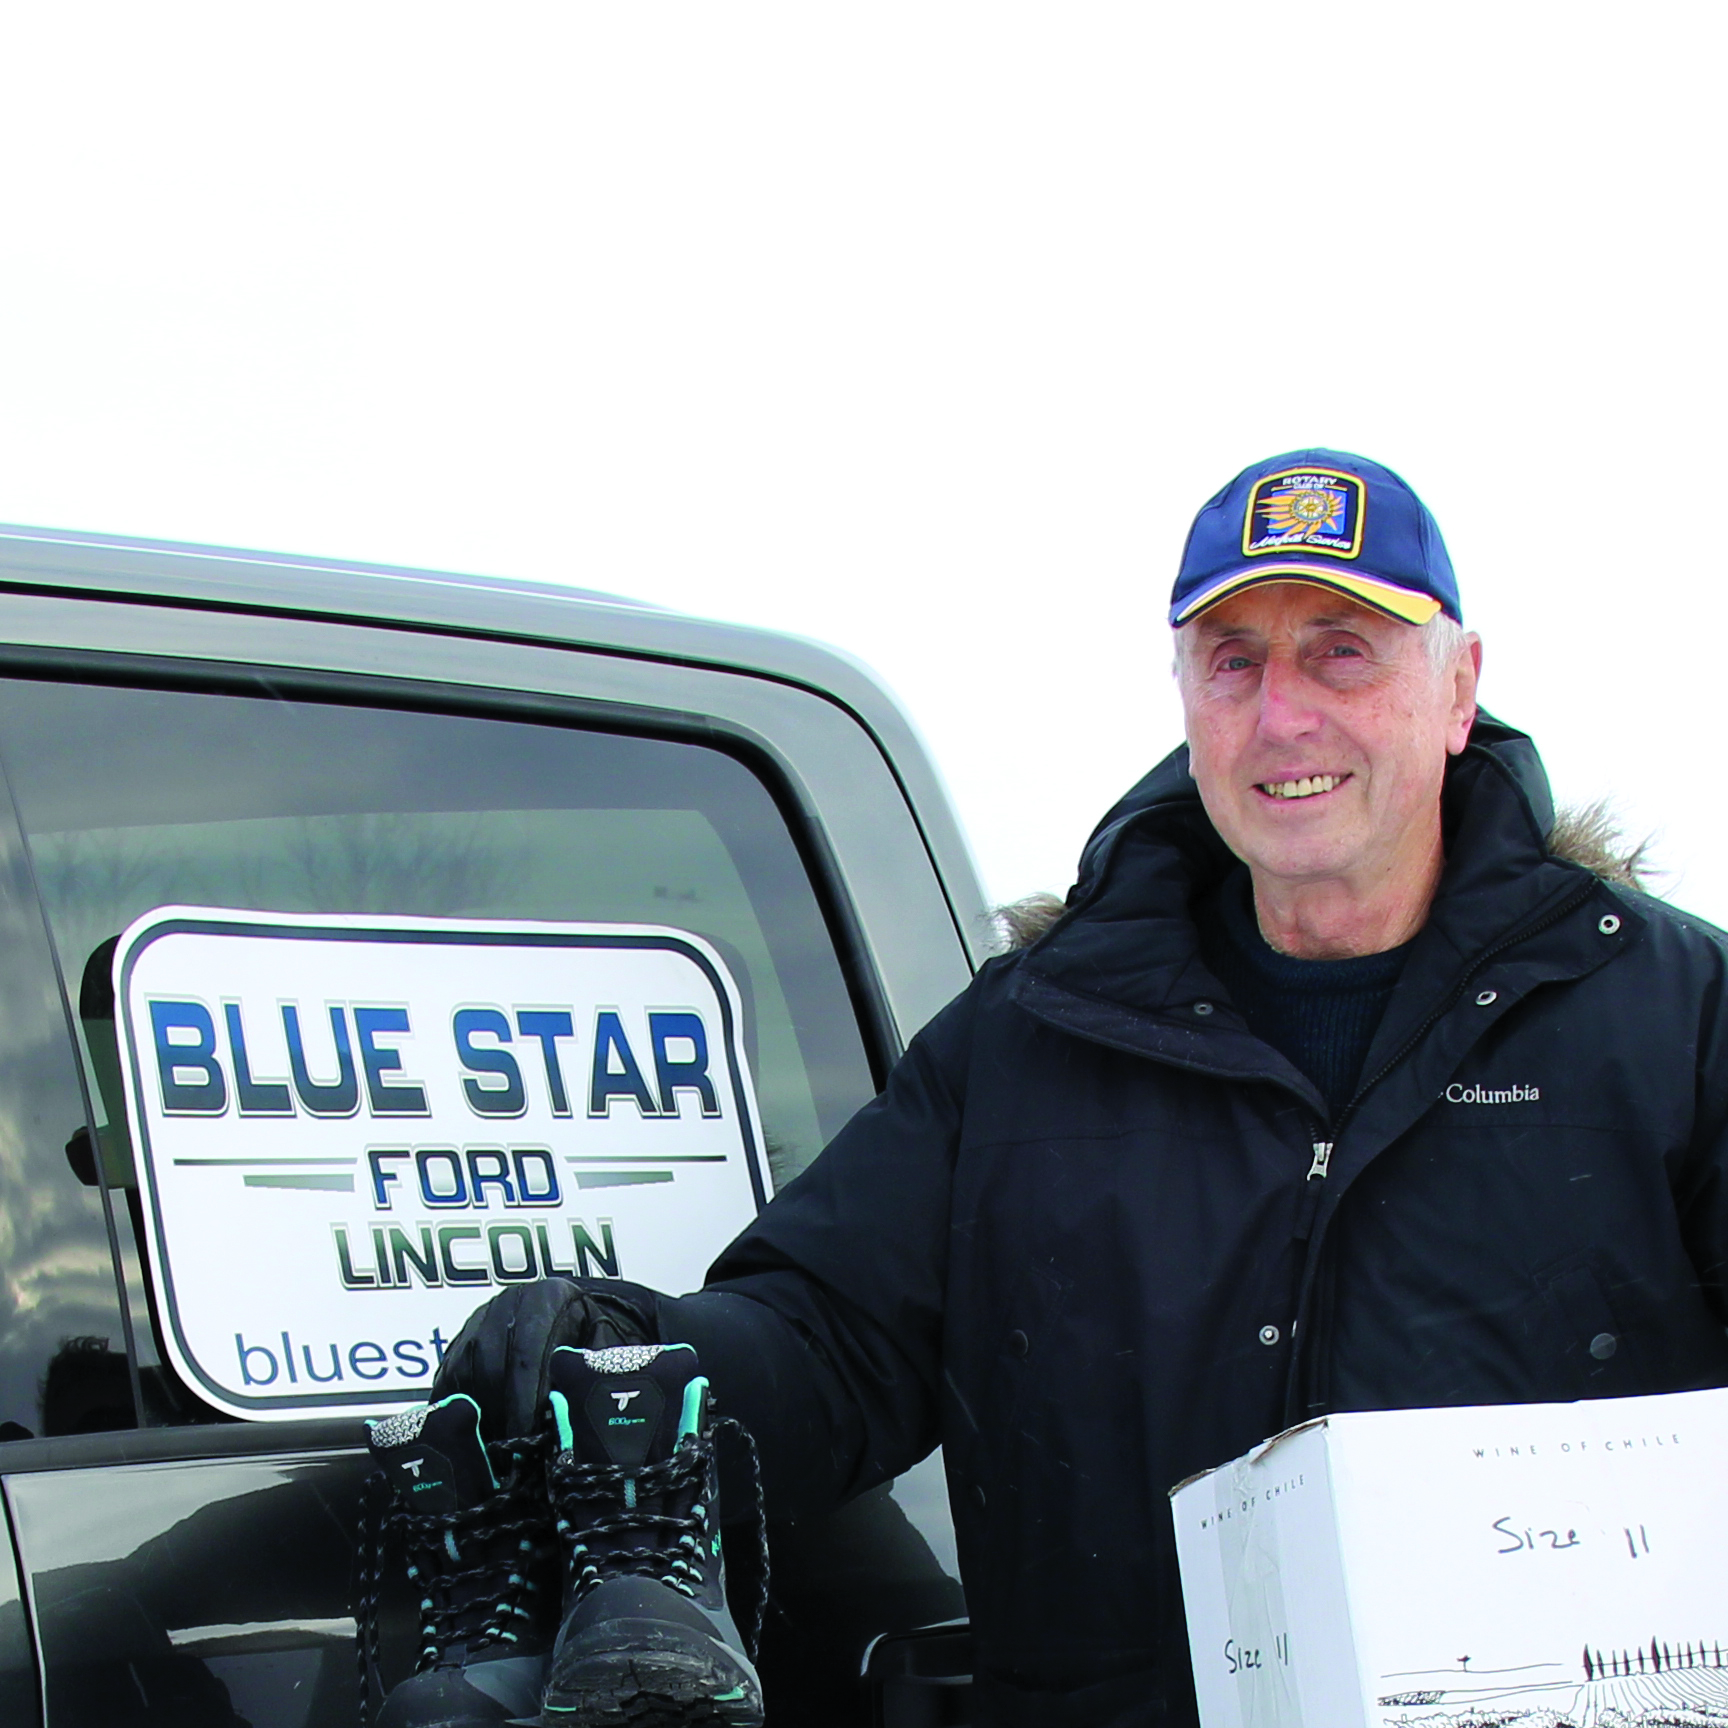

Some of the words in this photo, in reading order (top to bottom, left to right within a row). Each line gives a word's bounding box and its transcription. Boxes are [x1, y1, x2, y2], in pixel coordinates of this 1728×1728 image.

[1282, 475, 1338, 486] ROTARY
[146, 996, 430, 1117] BLUE
[452, 1004, 722, 1119] STAR
[1446, 1083, 1540, 1104] Columbia
[366, 1144, 563, 1209] FORD
[332, 1218, 622, 1290] LINCOLN
[235, 1326, 448, 1385] bluest
[1473, 1445, 1536, 1458] WINE
[1561, 1441, 1587, 1453] OF
[1605, 1434, 1679, 1451] CHILE
[1201, 1508, 1232, 1530] WINE
[1242, 1497, 1256, 1511] OF
[1266, 1474, 1305, 1501] CHILE
[1491, 1516, 1580, 1554] Size
[1224, 1639, 1262, 1674] Size
